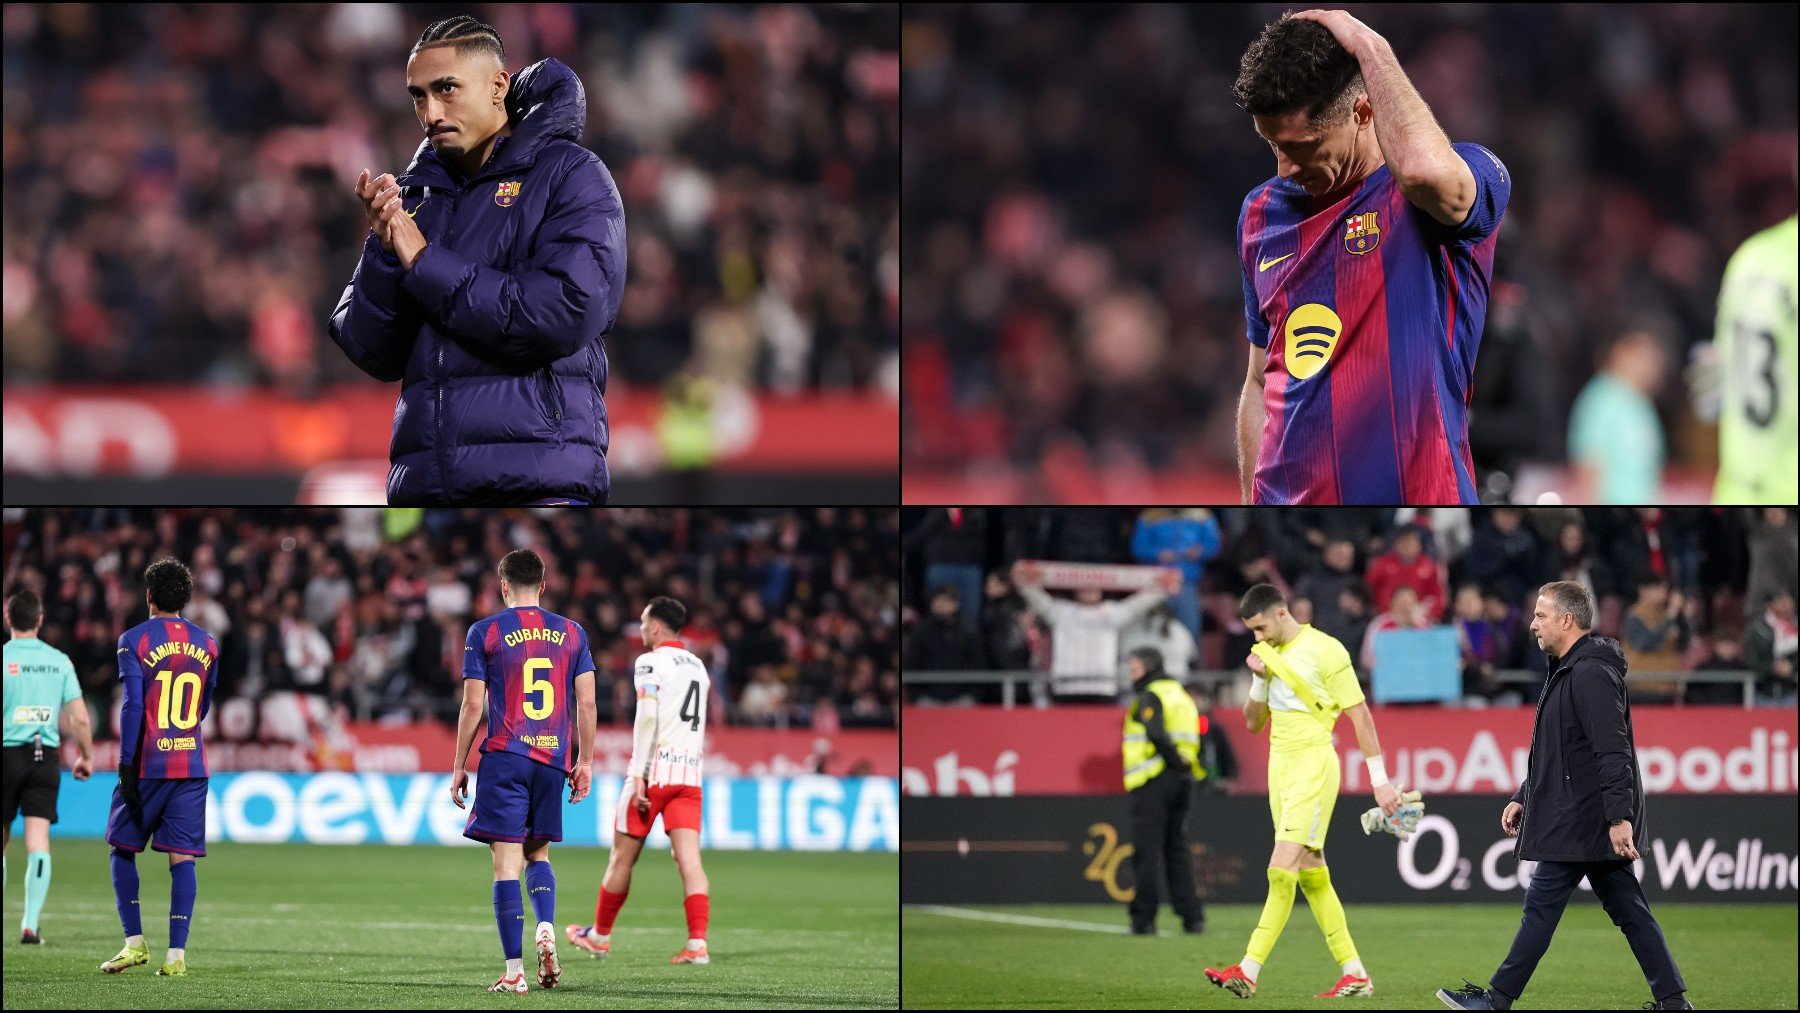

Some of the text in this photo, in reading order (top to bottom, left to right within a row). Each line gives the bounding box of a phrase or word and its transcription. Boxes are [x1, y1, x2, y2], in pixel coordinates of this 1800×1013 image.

[143, 641, 212, 670] LAMINE YAMAL
[504, 627, 567, 647] CUBARSÍ
[155, 670, 202, 730] 10
[522, 657, 555, 720] 5
[679, 680, 700, 732] 4
